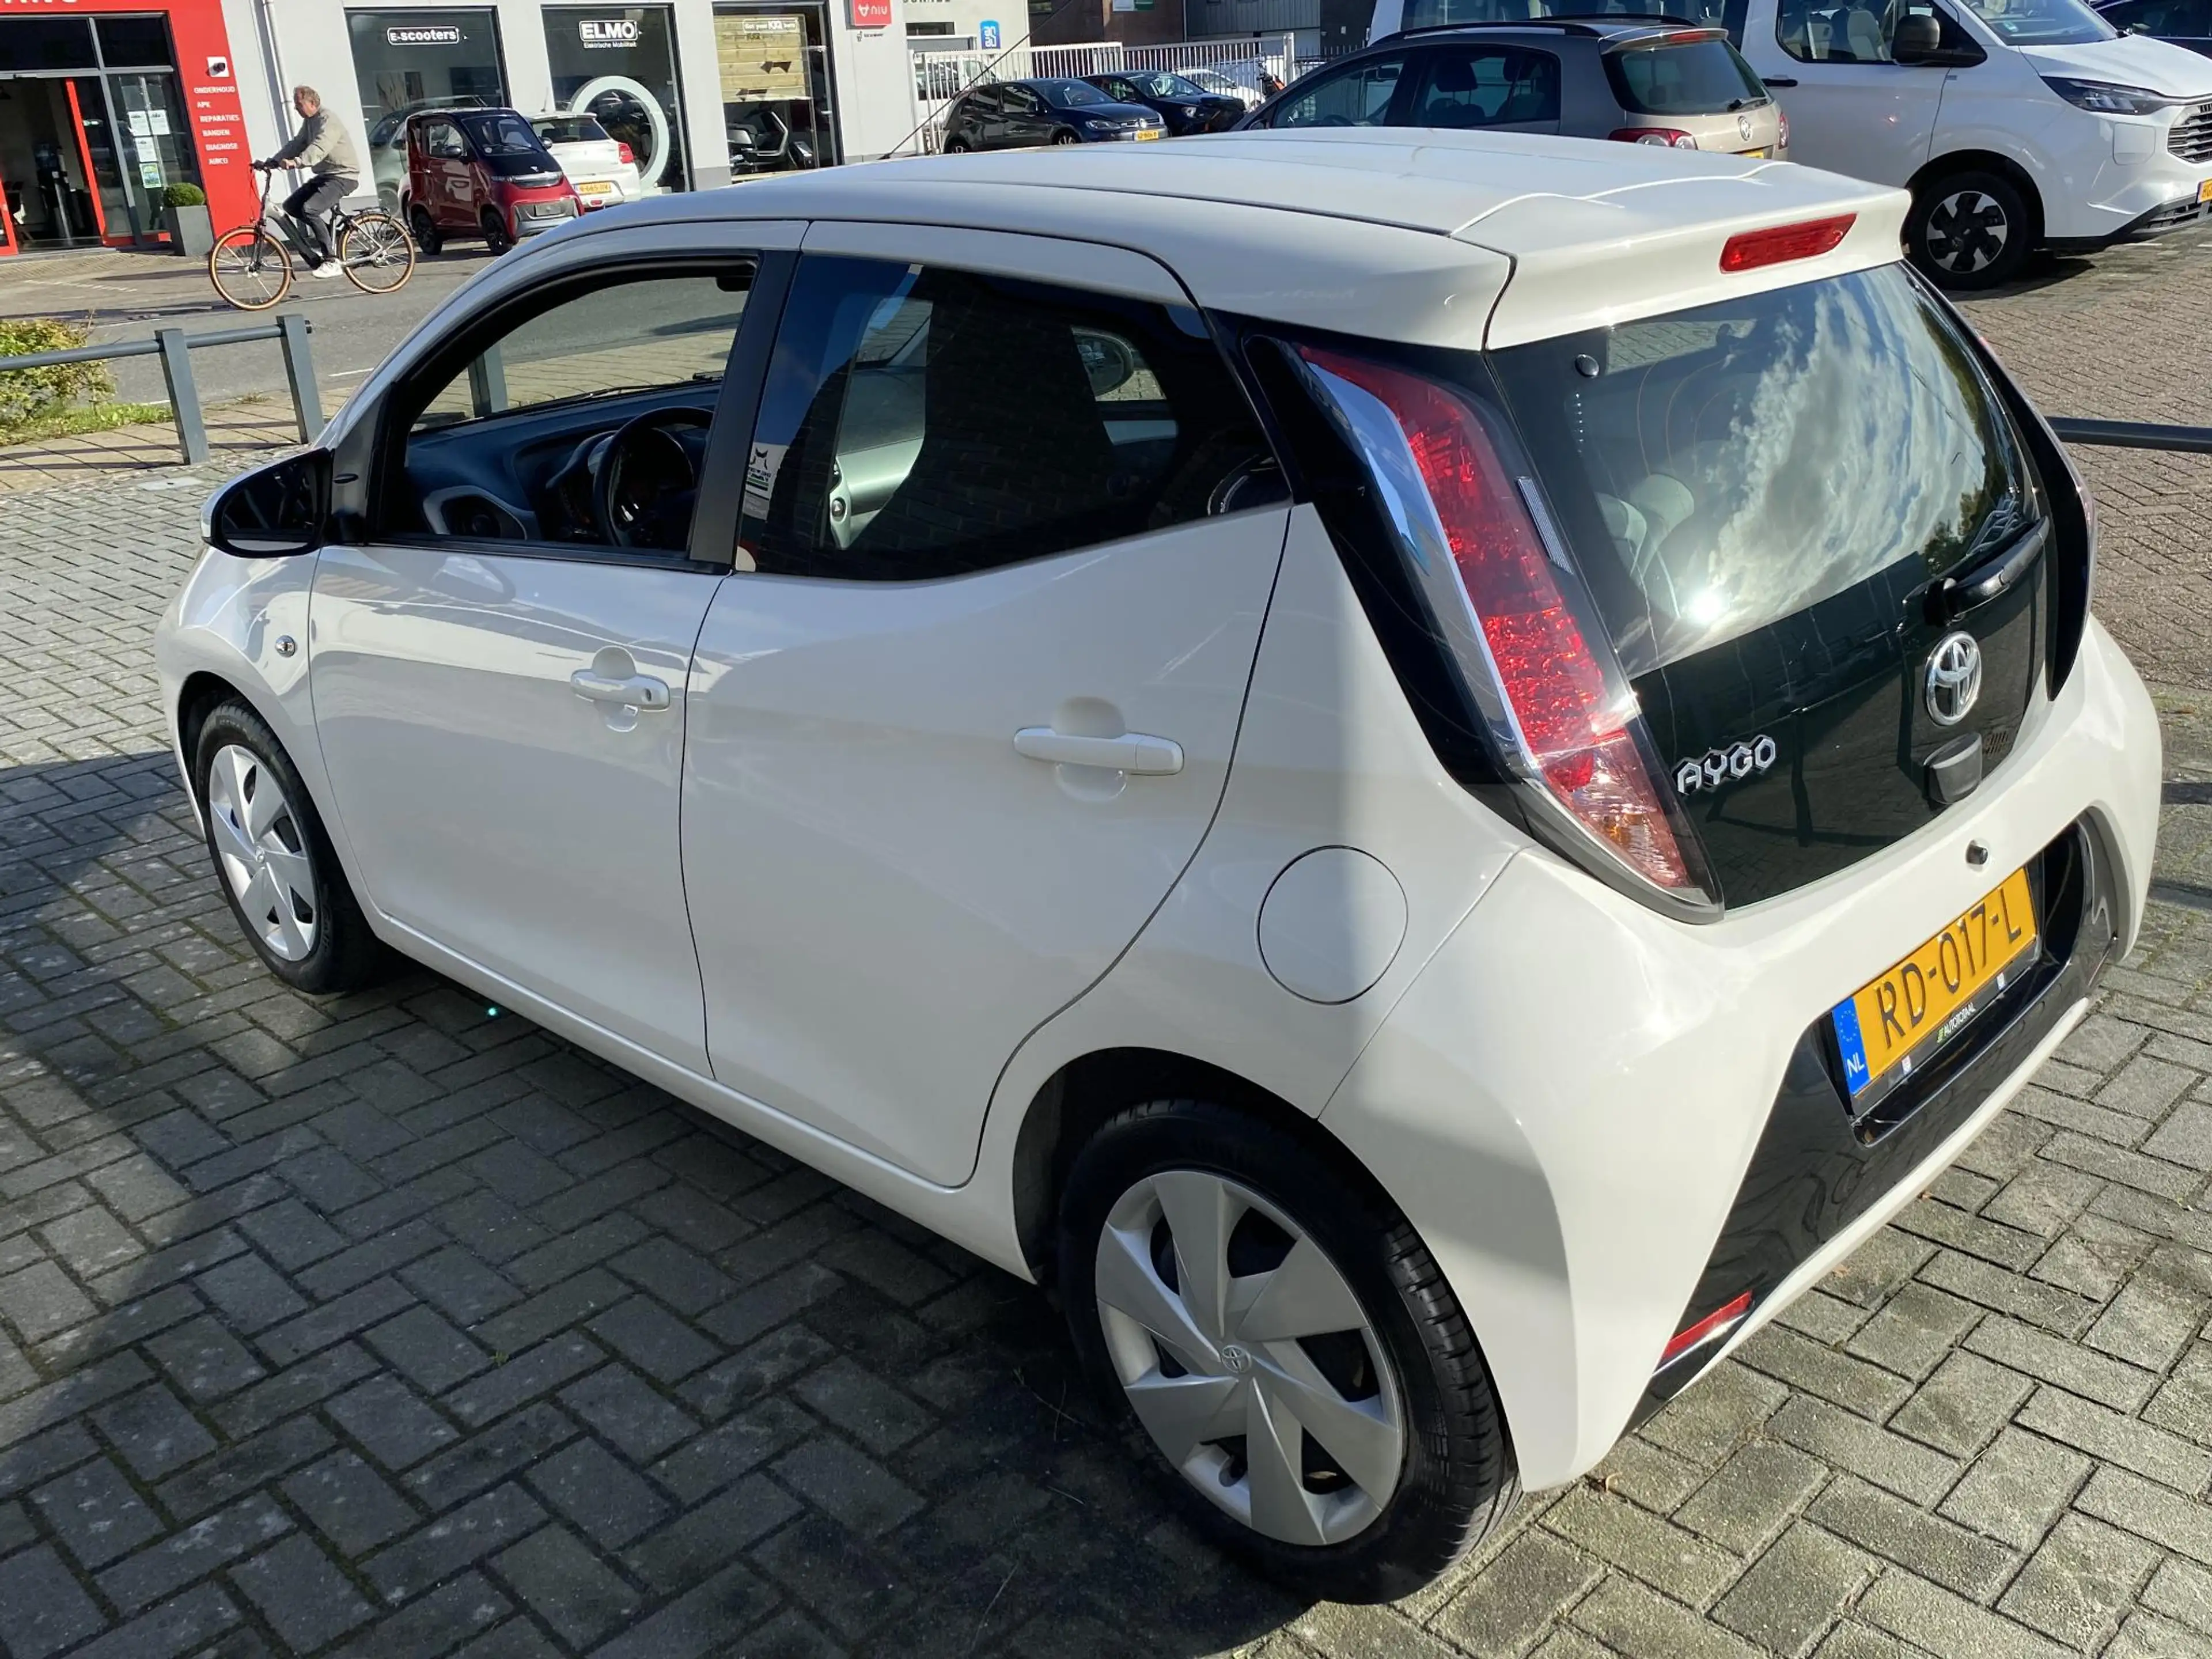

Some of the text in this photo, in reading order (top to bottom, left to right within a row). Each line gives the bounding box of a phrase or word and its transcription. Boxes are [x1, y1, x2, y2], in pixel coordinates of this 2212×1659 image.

[581, 22, 635, 39] ELMO
[200, 115, 240, 123] REPARATIES
[206, 143, 238, 151] DIAGNOSE
[1676, 737, 1776, 794] AYGO
[1873, 886, 2022, 1050] RD-017-L
[1846, 1054, 1865, 1080] NL
